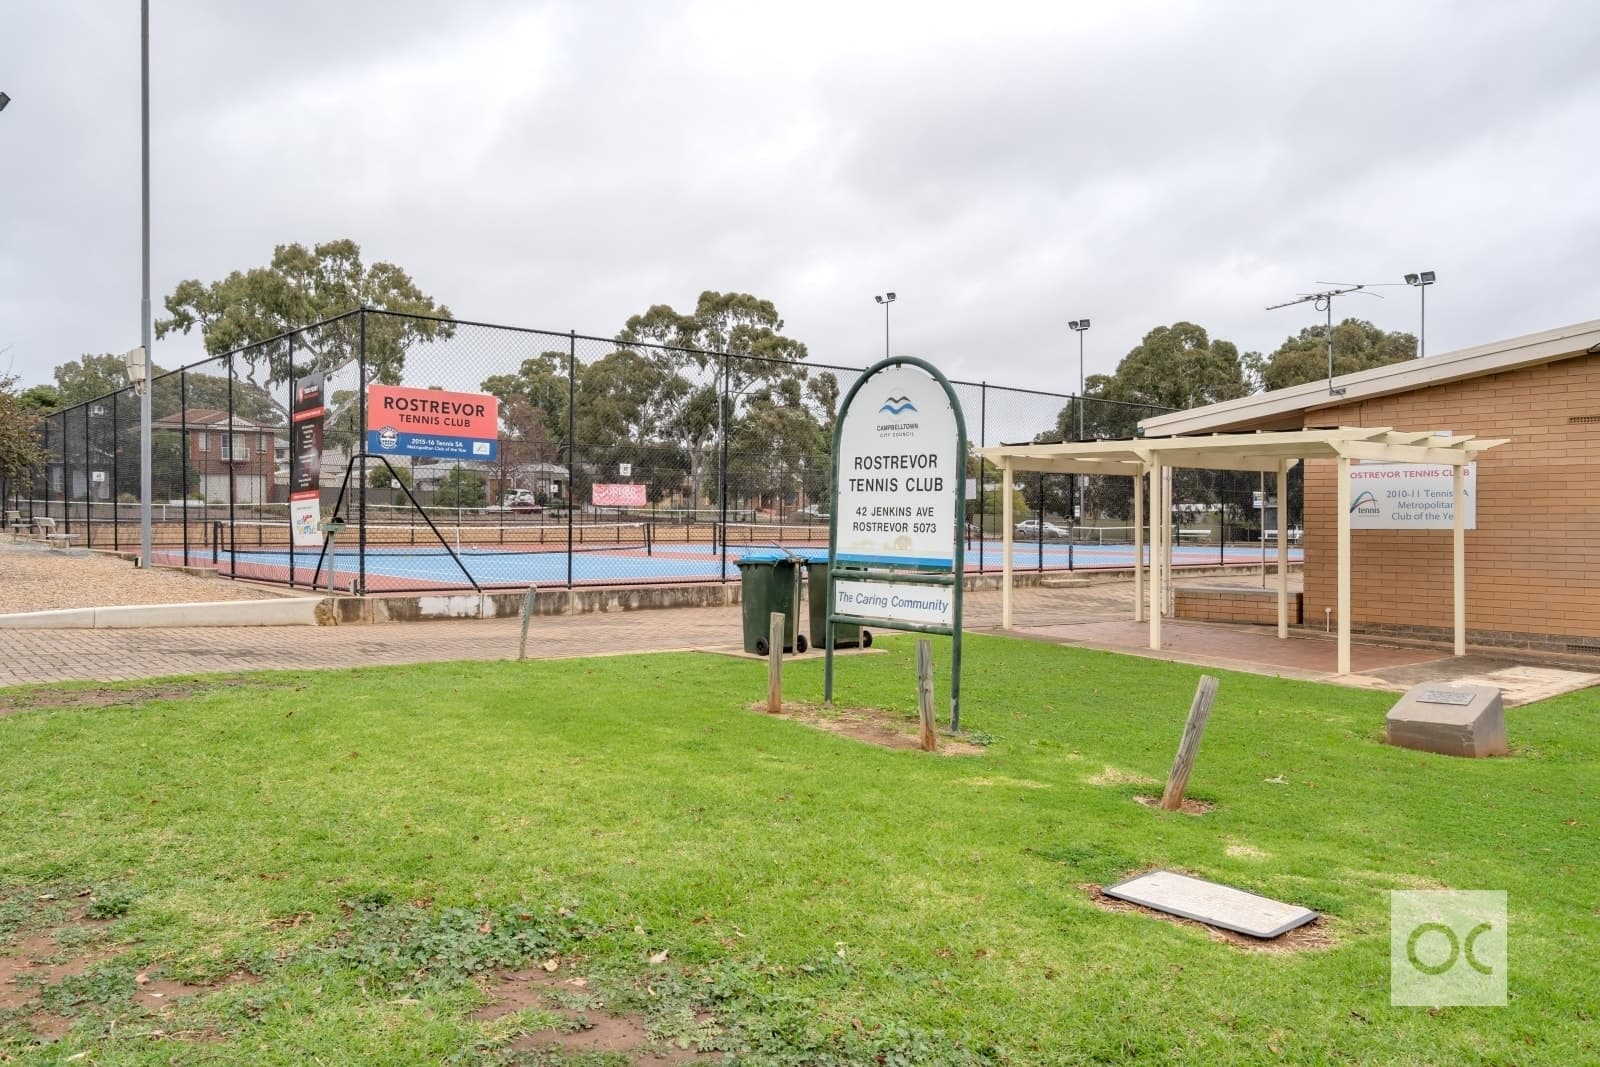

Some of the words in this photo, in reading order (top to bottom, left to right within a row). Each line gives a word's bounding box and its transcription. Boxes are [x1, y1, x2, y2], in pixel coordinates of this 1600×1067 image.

[384, 396, 485, 417] ROSTREVOR
[399, 414, 440, 425] TENNIS
[444, 417, 471, 428] CLUB
[876, 423, 918, 432] CAMPBELLTOWN
[411, 438, 435, 446] 2015-16
[854, 454, 937, 470] ROSTREVOR
[1350, 470, 1400, 479] OSTREVOR
[1403, 470, 1440, 478] TENNIS
[849, 478, 898, 492] TENNIS
[905, 477, 944, 492] CLUB
[1386, 490, 1420, 498] 2010-11
[1424, 489, 1454, 498] Tennis
[856, 506, 868, 517] 42
[871, 506, 912, 517] JENKINS
[916, 506, 934, 517] AVE
[1392, 512, 1412, 520] Club
[1414, 512, 1424, 520] of
[1424, 512, 1439, 520] the
[853, 522, 908, 533] ROSTREVOR
[913, 522, 936, 534] 5073
[838, 592, 854, 603] The
[855, 593, 888, 608] Caring
[891, 595, 948, 613] Community
